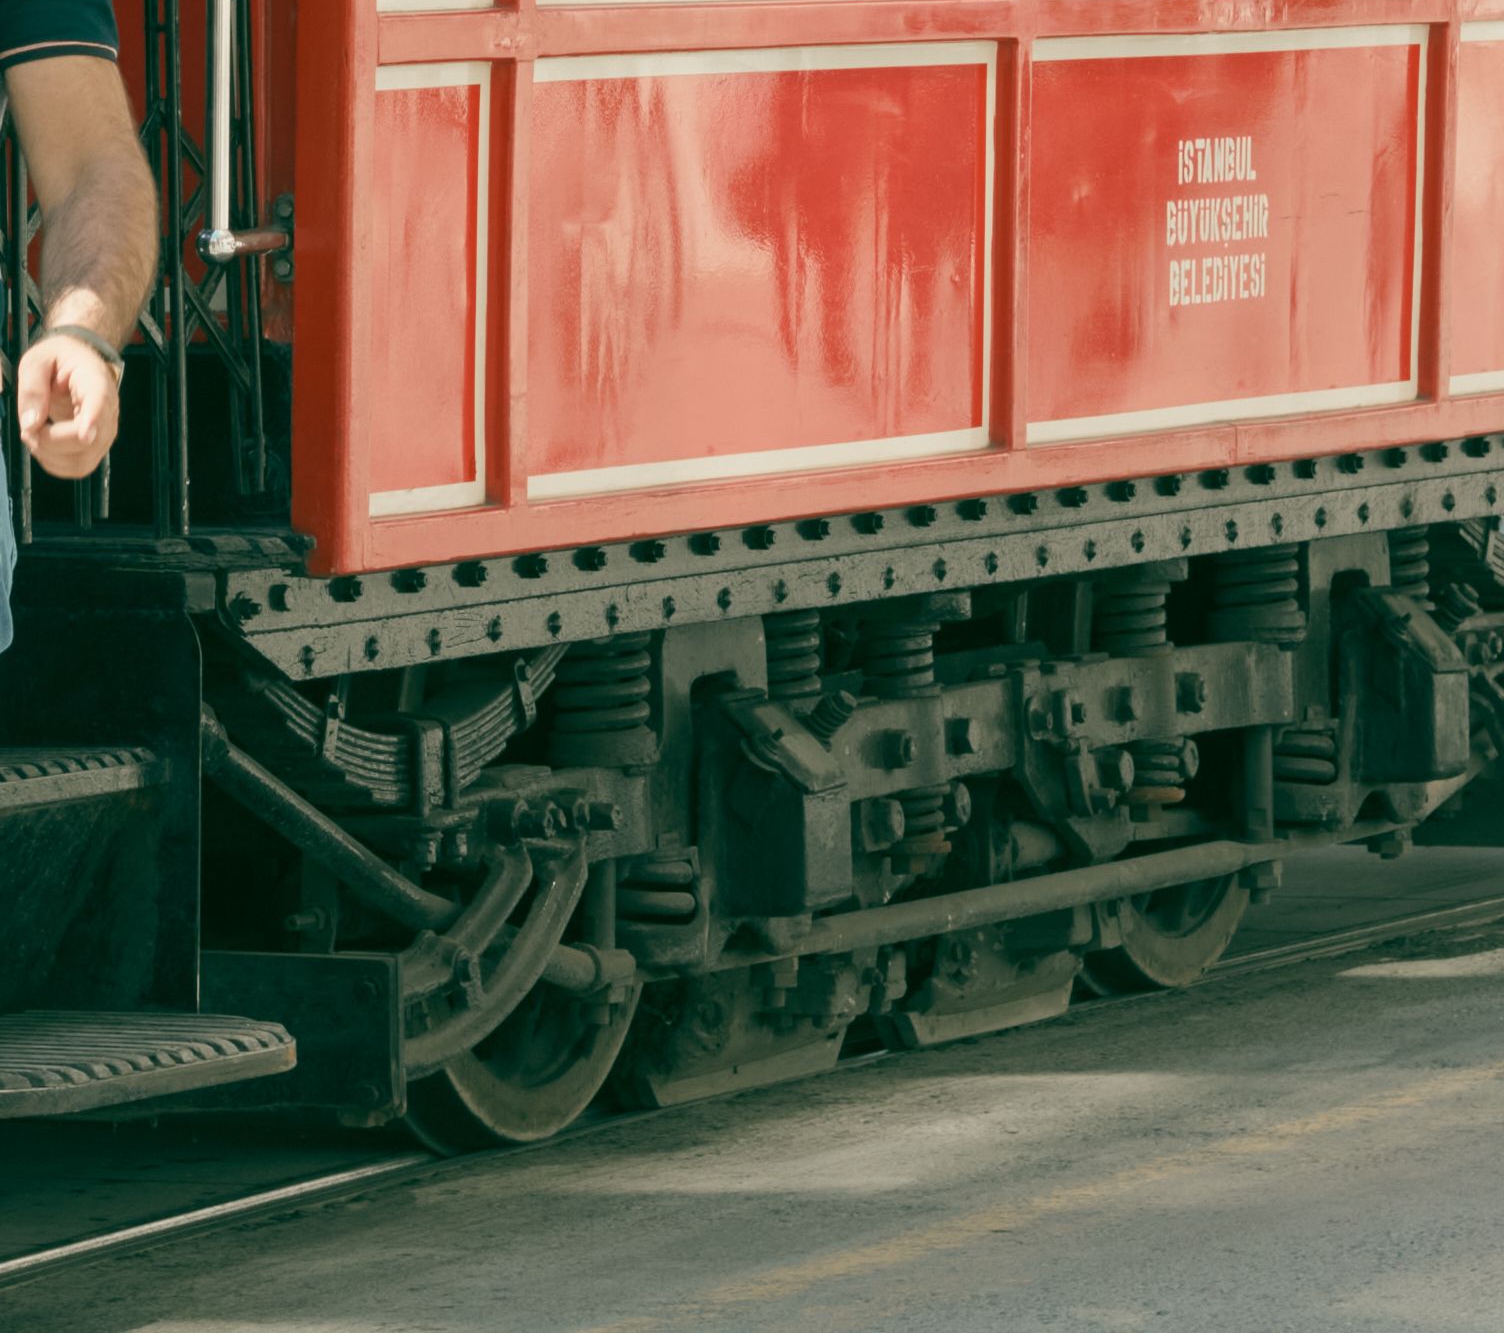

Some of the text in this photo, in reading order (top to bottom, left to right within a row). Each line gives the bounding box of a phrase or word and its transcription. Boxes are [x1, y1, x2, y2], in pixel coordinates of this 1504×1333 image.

[1178, 136, 1257, 184] İSTANBUL
[1166, 193, 1269, 248] BÜYÜKŞEHİR
[1169, 252, 1266, 307] BELEDİYESİ
